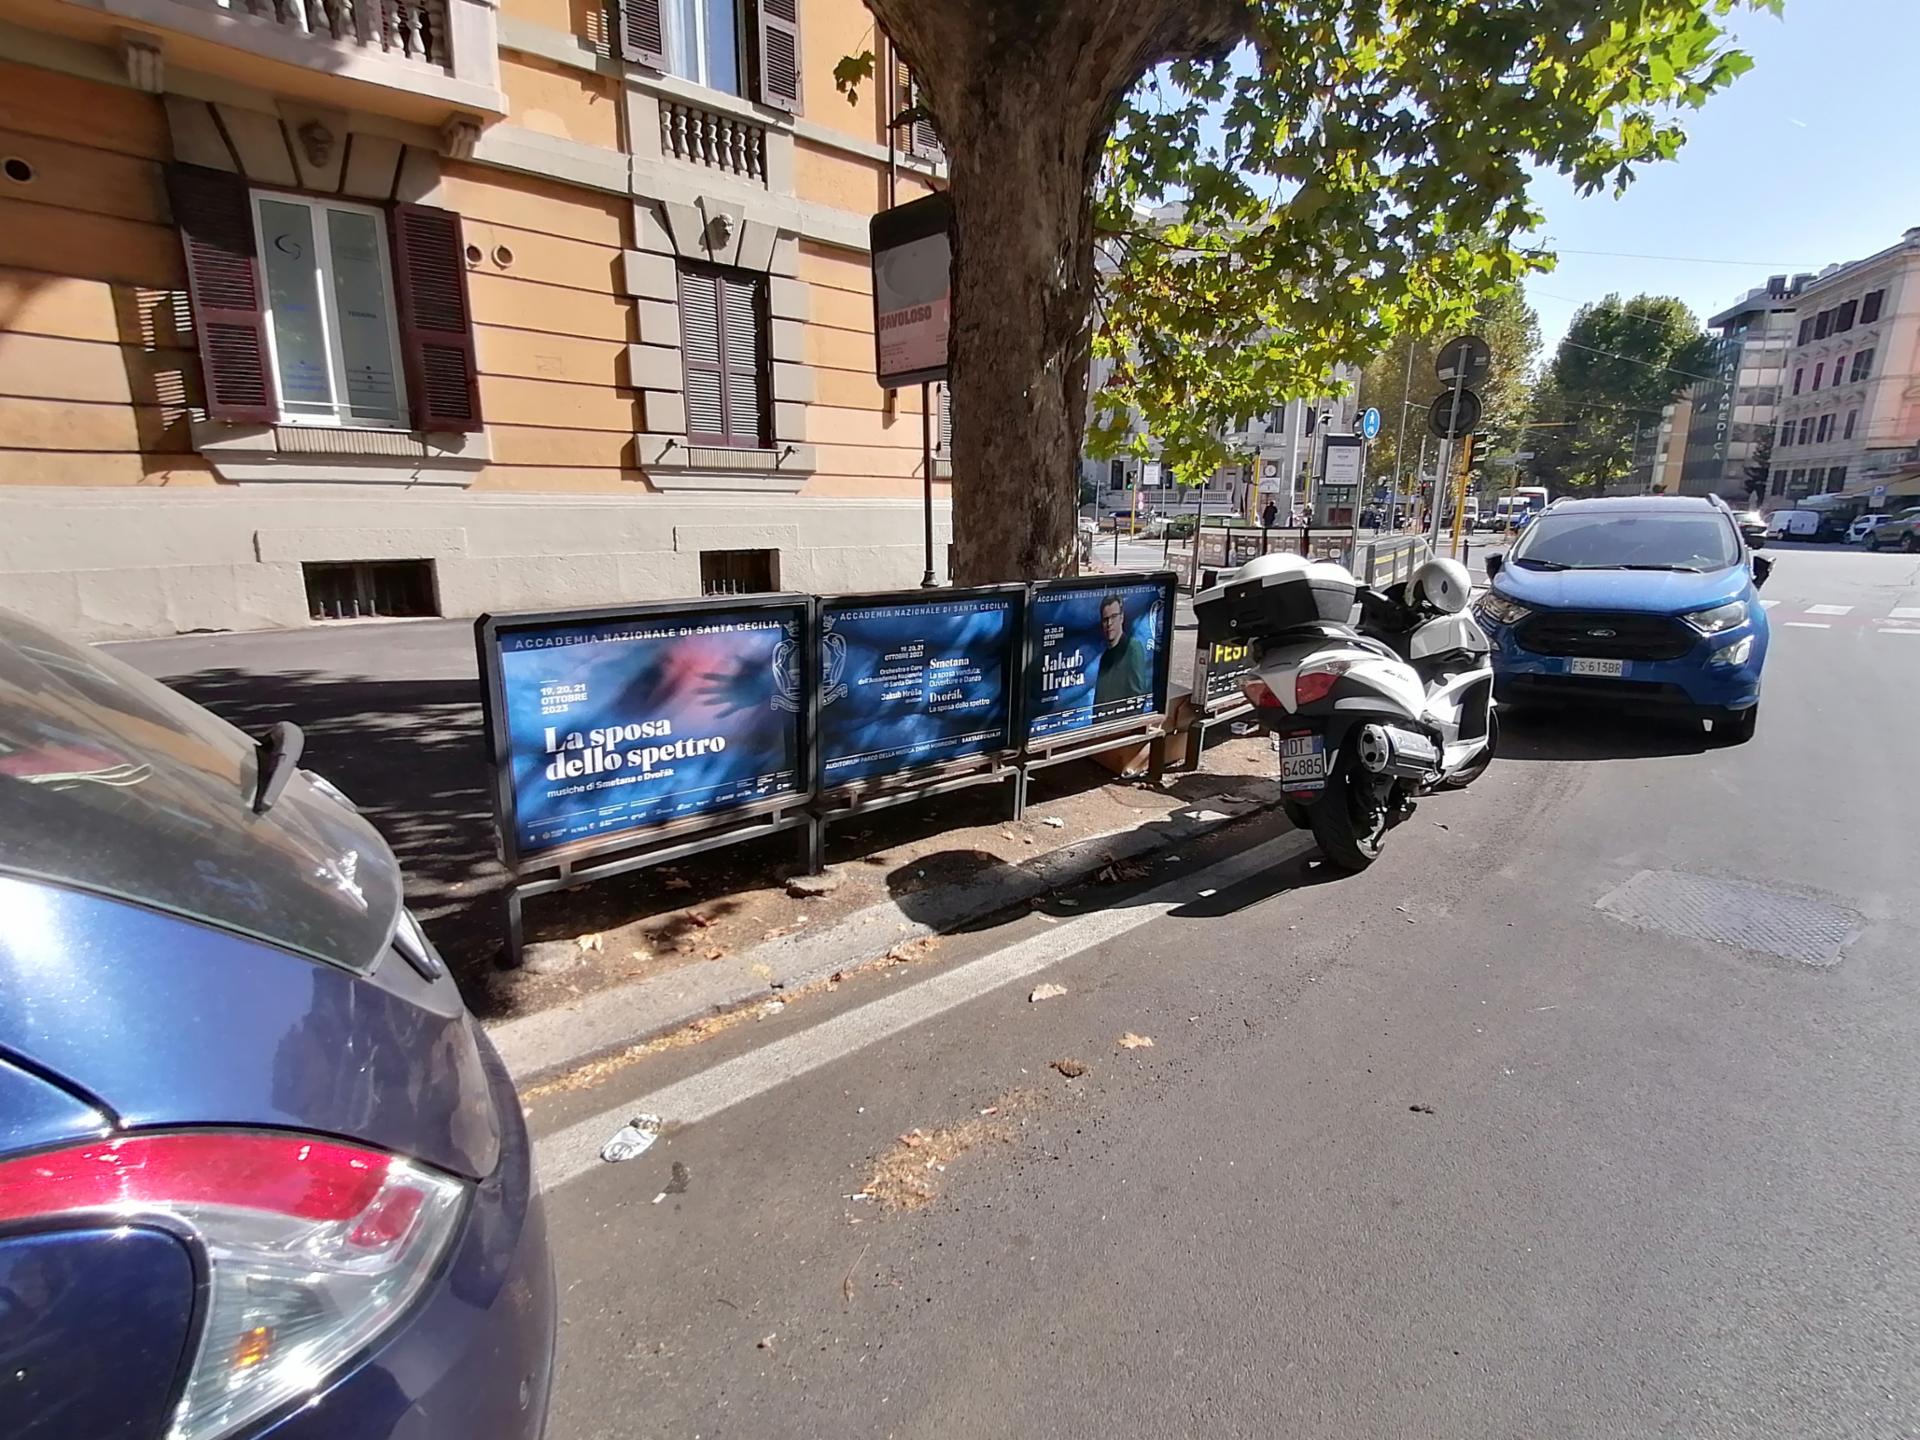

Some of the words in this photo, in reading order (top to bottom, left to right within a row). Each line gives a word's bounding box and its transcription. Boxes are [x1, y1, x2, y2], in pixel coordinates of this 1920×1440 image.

[880, 305, 932, 331] FAVOLOSO
[1712, 363, 1735, 460] ALTAMEDICA
[1037, 594, 1073, 603] ACCADEMIA
[840, 611, 892, 621] ACCADEMIA
[894, 606, 940, 617] NAZIONALE
[954, 605, 977, 613] SANTA
[980, 601, 1009, 611] CECILIA
[515, 634, 600, 649] ACCADEMIA
[603, 628, 676, 642] NAZIONALE
[680, 627, 692, 636] DI
[696, 624, 734, 635] SANTA
[737, 620, 780, 631] CECILIA
[929, 658, 970, 670] Smetana
[1042, 648, 1084, 673] Jakub
[574, 683, 586, 692] 21
[540, 692, 588, 706] OTTOBRE
[541, 703, 569, 716] 2023
[544, 726, 585, 753] La
[589, 719, 672, 752] sposa
[1290, 738, 1305, 755] DT
[545, 746, 623, 781] dello
[626, 736, 726, 772] spettro
[825, 757, 860, 770] AUDITORIUM
[861, 753, 879, 764] PARCO
[879, 751, 896, 761] DELLA
[1283, 757, 1322, 777] 64885
[547, 785, 585, 798] musiche
[586, 781, 596, 791] di
[595, 775, 636, 789] Smetana
